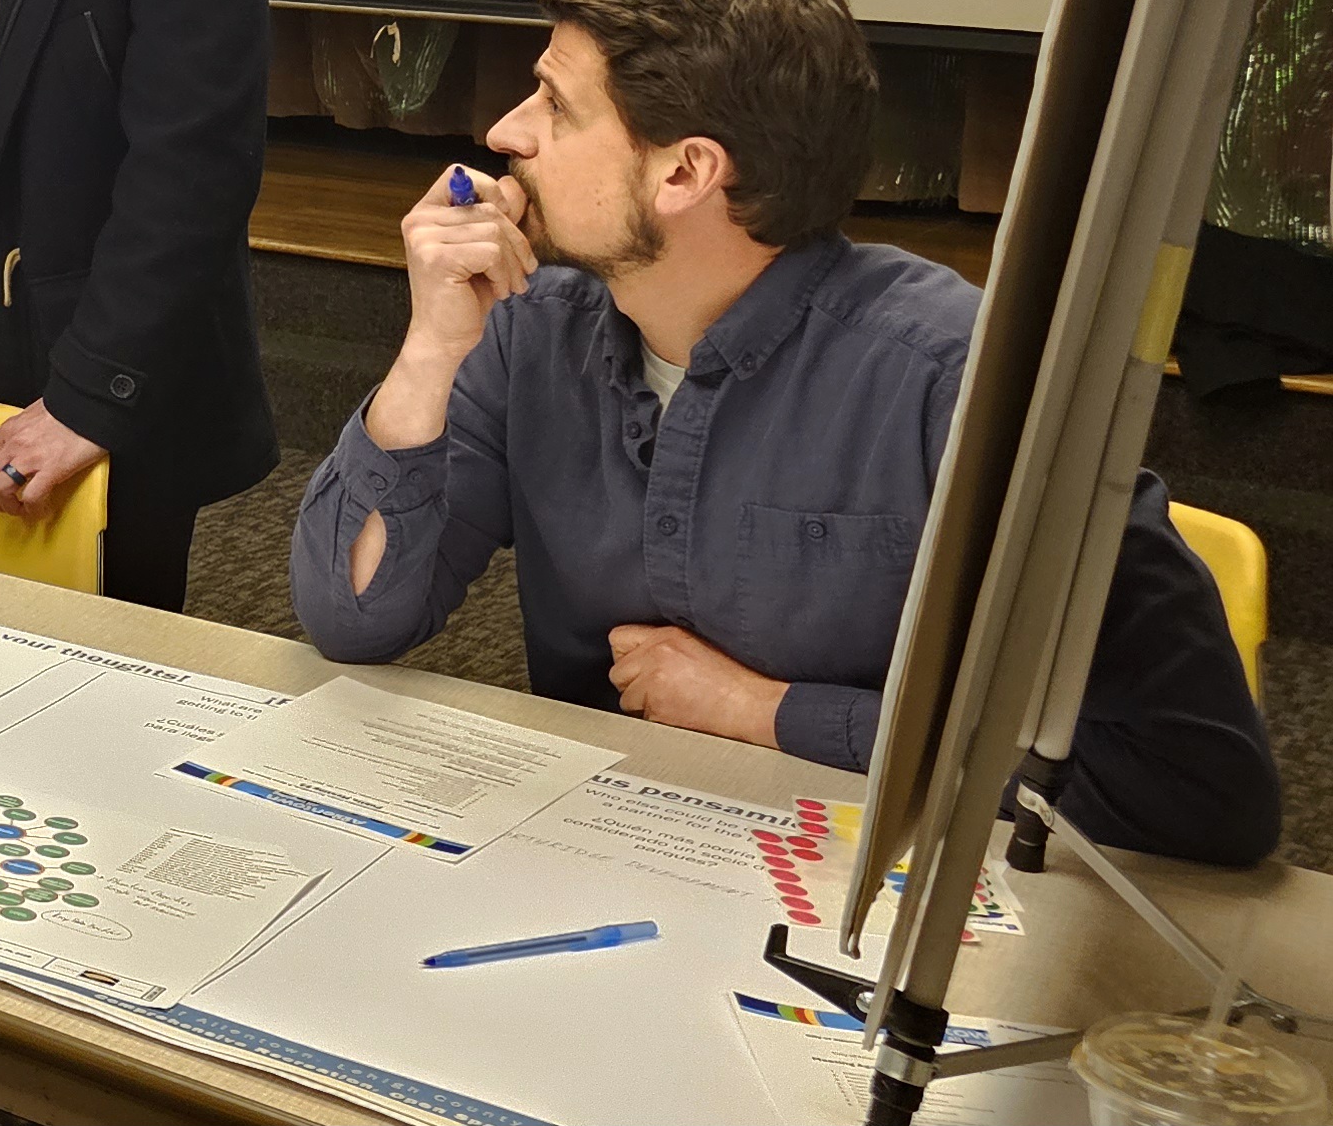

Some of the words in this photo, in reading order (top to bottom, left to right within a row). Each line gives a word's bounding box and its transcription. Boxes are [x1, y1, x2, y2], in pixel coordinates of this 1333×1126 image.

[60, 647, 191, 684] thoughts!
[176, 699, 226, 715] getting
[229, 709, 244, 719] to
[201, 695, 236, 709] What
[238, 705, 263, 715] are
[144, 721, 177, 735] para
[585, 788, 621, 801] Who
[625, 798, 660, 811] else
[664, 806, 713, 824] could
[717, 819, 739, 830] be
[617, 804, 682, 824] partner
[685, 819, 711, 832] for
[713, 827, 742, 839] the
[563, 817, 668, 848] considerado
[674, 844, 696, 855] un
[700, 851, 748, 868] socio
[592, 816, 652, 835] ¿Quién
[658, 831, 695, 845] más
[698, 841, 756, 860] podría
[633, 843, 719, 868] parques?
[94, 993, 248, 1048] Comprehensive
[254, 1046, 380, 1093] Recreation,
[389, 1091, 447, 1115] Open
[337, 1062, 419, 1094] Lehigh
